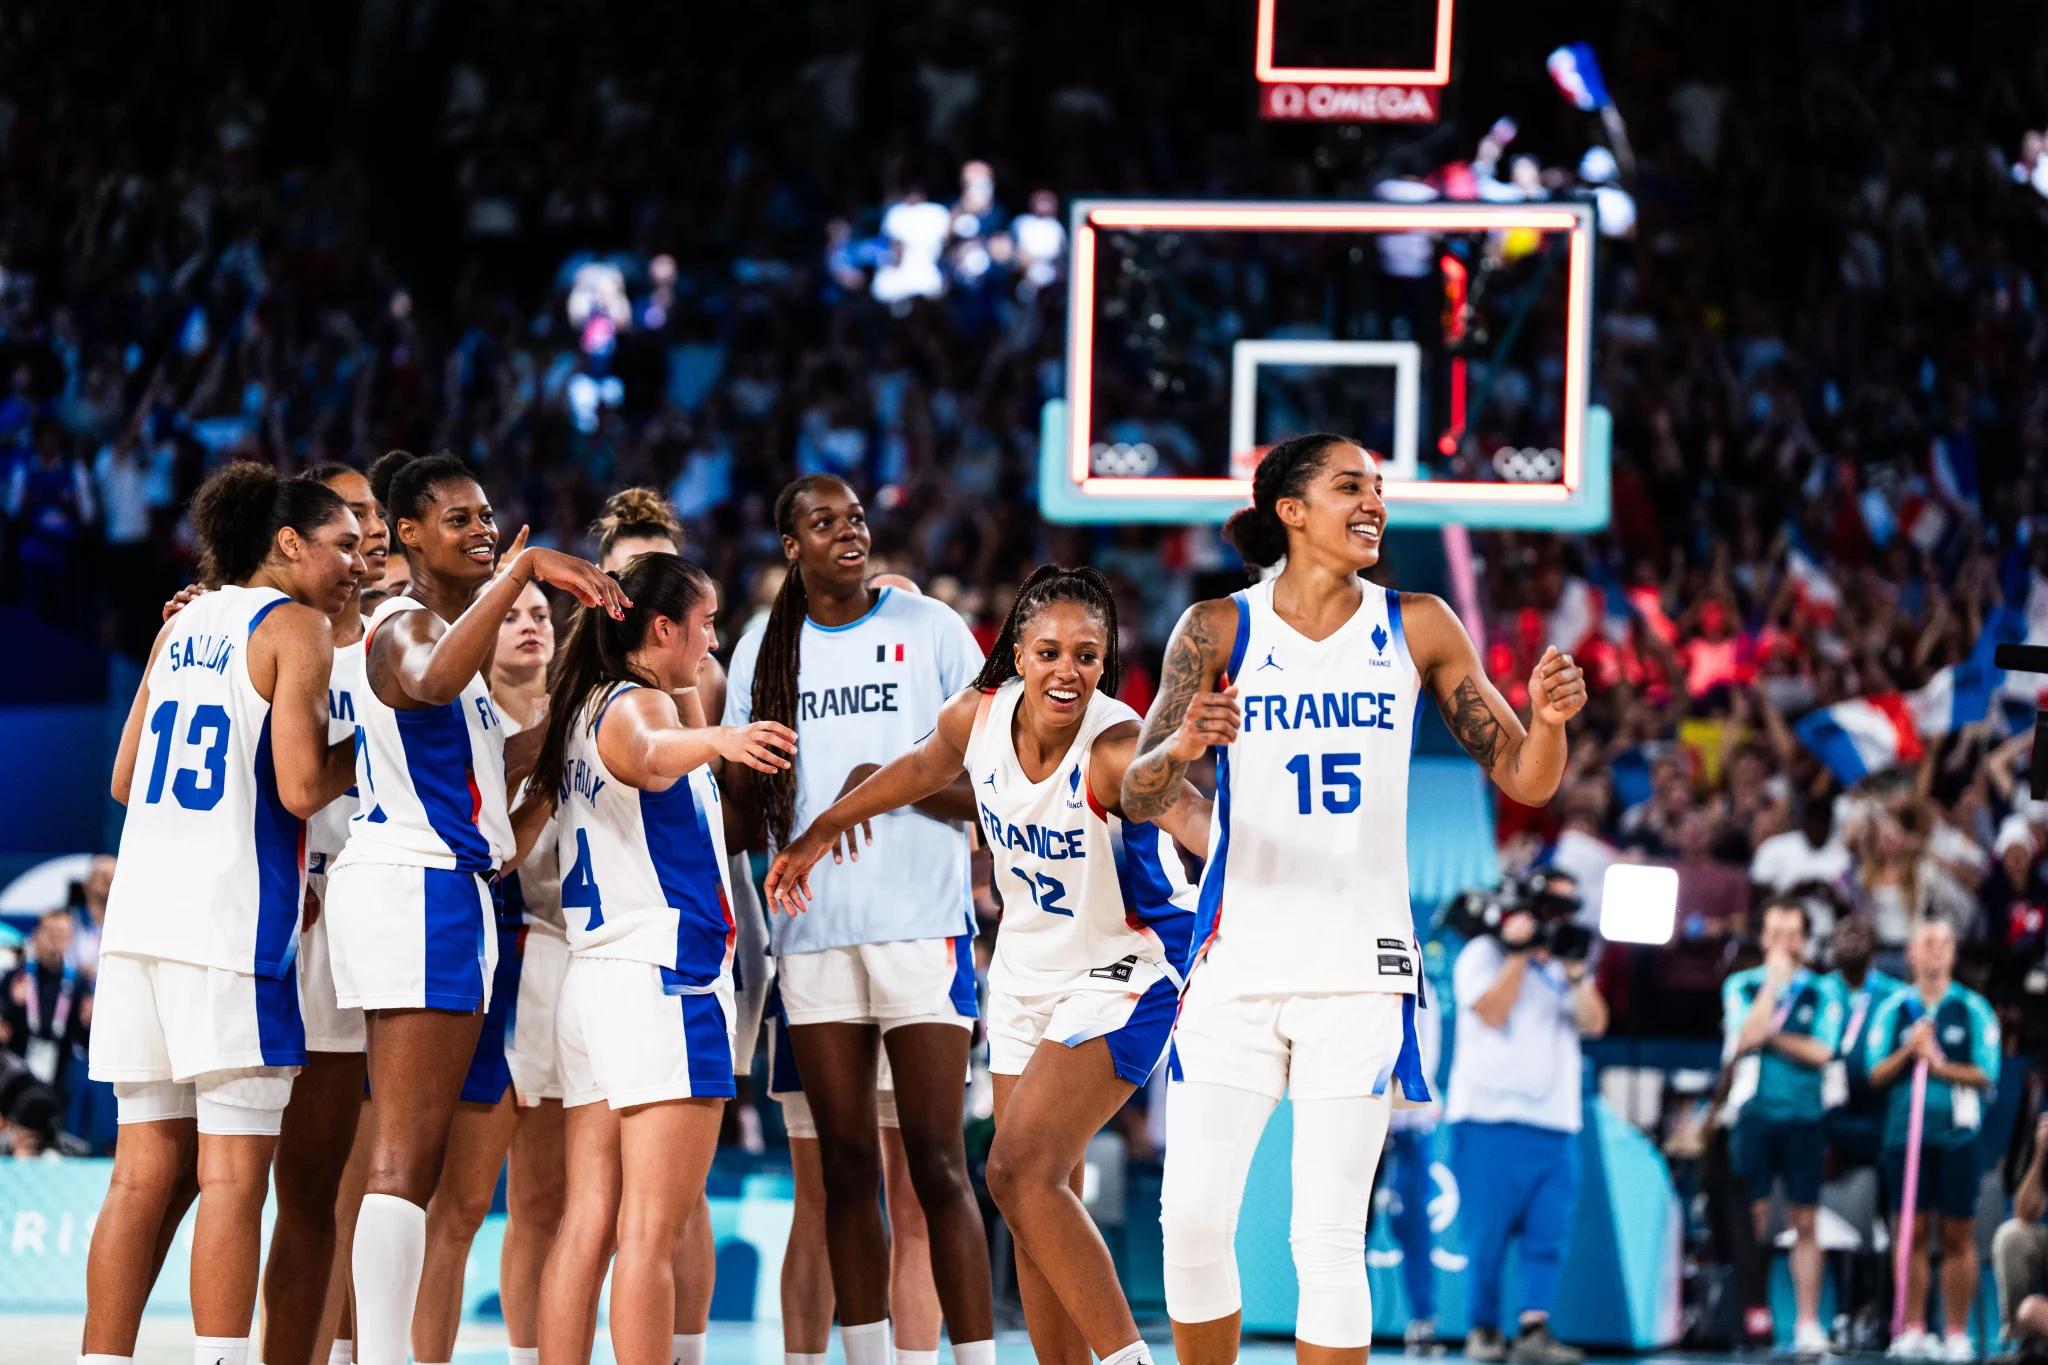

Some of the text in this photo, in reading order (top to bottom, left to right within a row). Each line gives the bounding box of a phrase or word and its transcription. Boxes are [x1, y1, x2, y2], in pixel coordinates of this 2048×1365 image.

[1307, 84, 1434, 119] OMEGA
[1368, 658, 1392, 668] FRANCE
[798, 682, 899, 722] RANCE
[1244, 691, 1396, 733] FRANCE
[145, 700, 231, 812] 13
[1285, 752, 1362, 815] 15
[980, 801, 1086, 861] FRANCE
[561, 827, 605, 932] 4
[1010, 866, 1075, 918] 12
[1116, 968, 1128, 977] 46
[1401, 961, 1411, 971] 42
